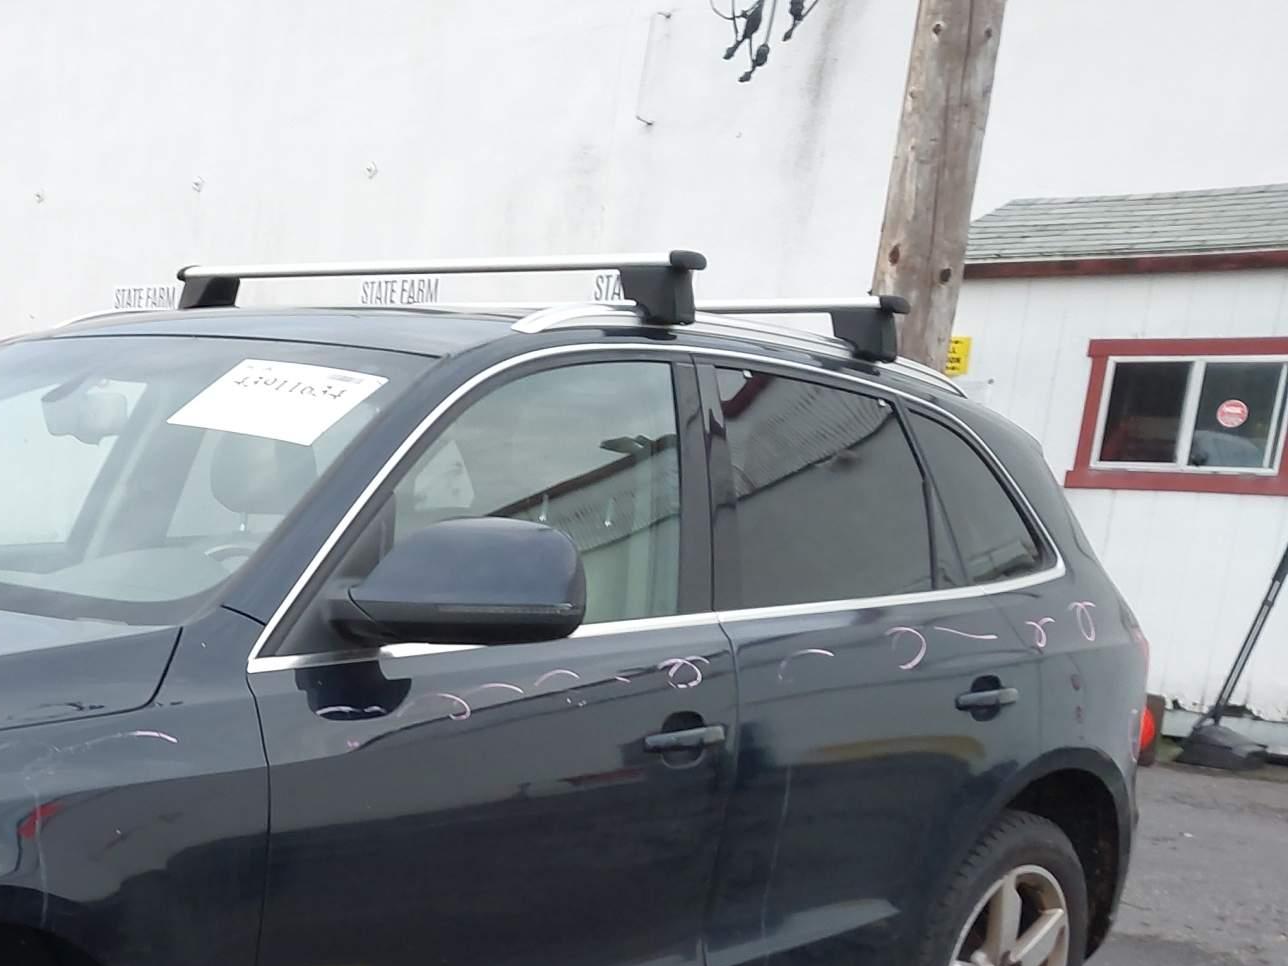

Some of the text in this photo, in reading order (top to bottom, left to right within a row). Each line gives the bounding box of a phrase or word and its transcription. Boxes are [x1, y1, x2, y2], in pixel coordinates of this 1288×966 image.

[114, 286, 176, 310] STATE FARM
[360, 277, 440, 305] STATE FARM
[594, 274, 622, 301] STA
